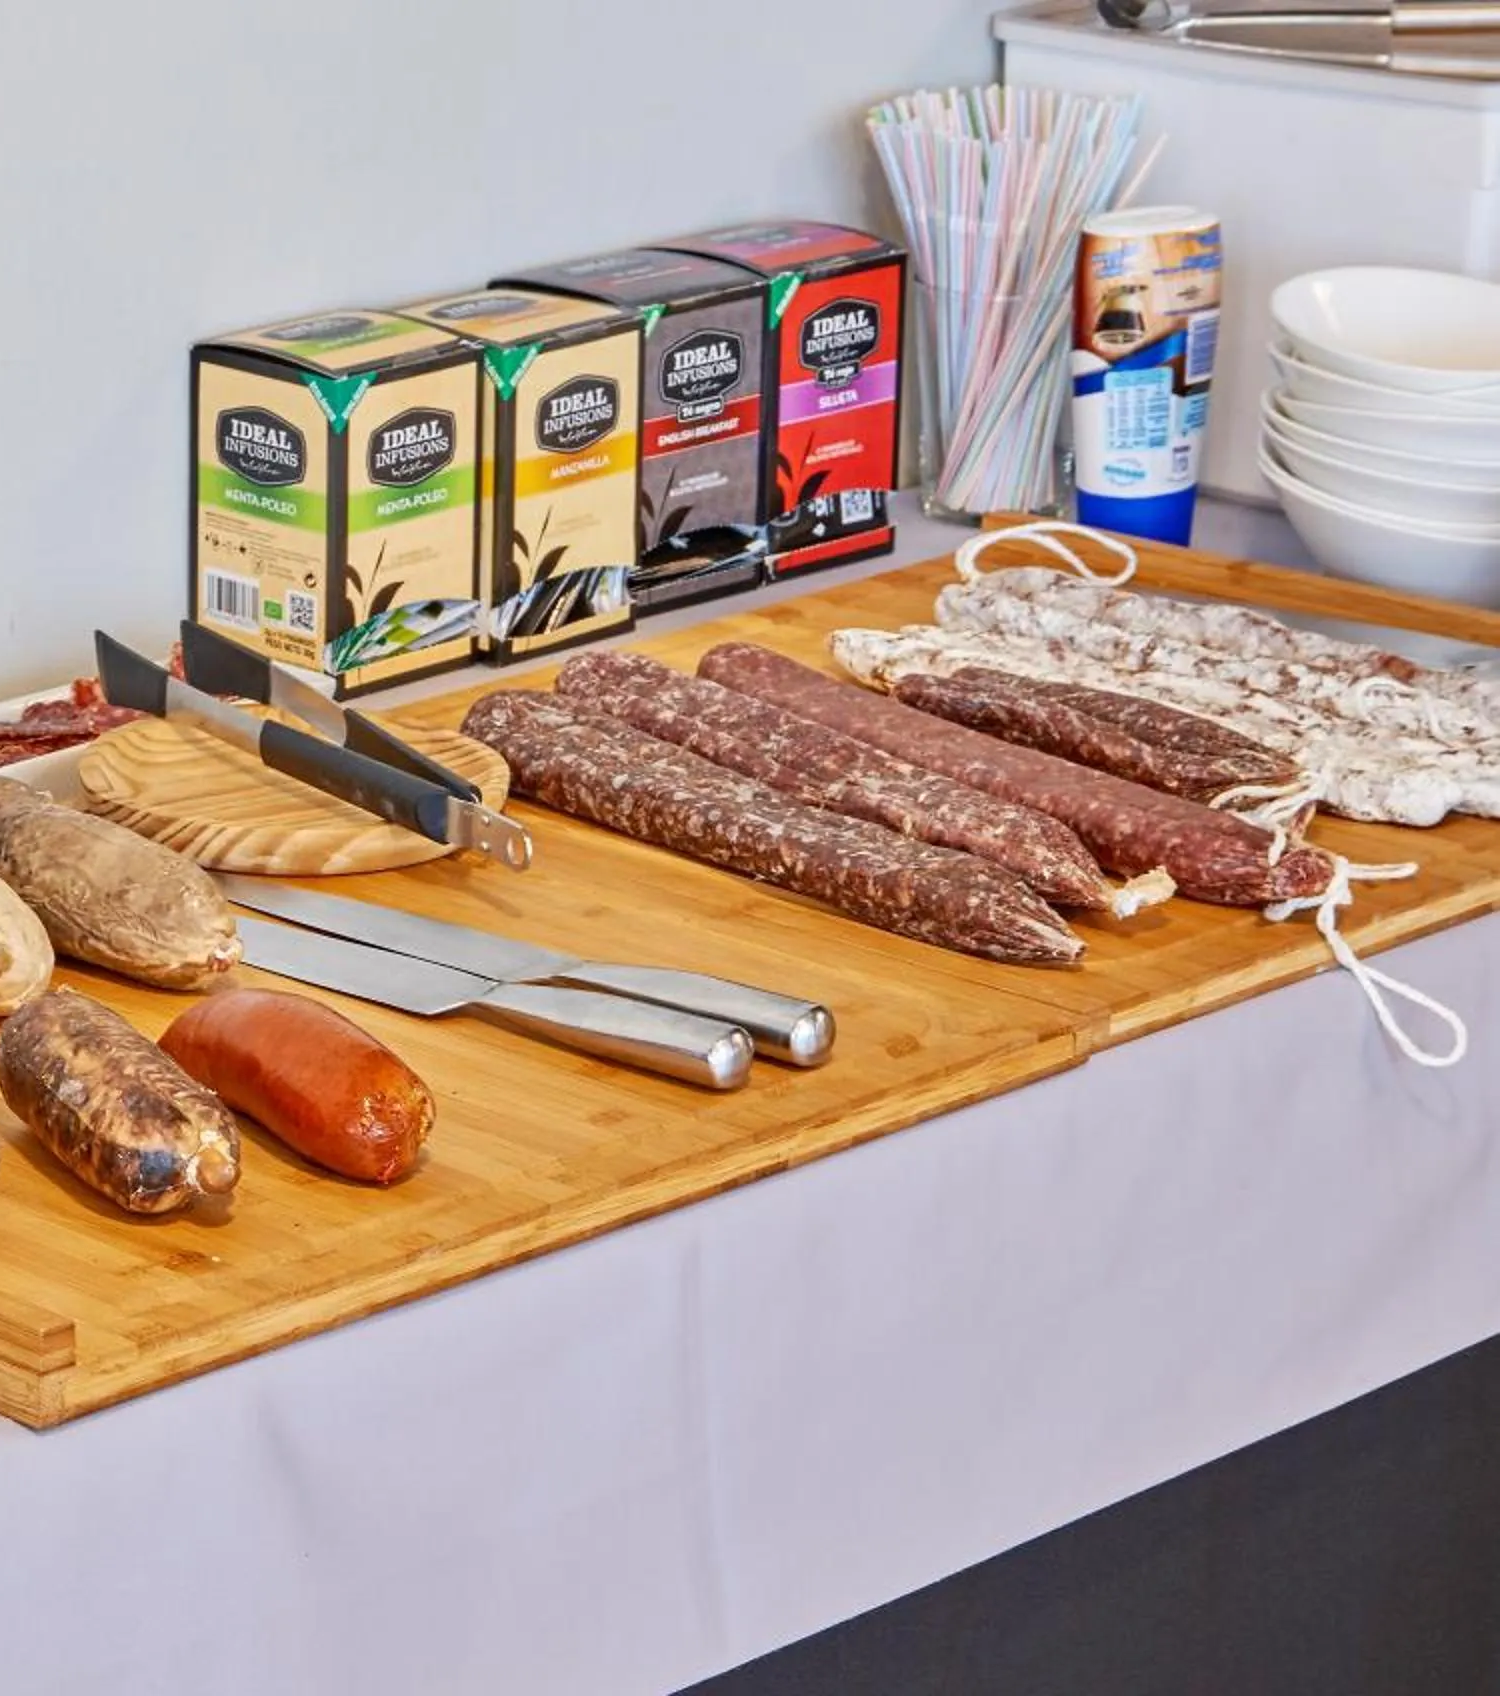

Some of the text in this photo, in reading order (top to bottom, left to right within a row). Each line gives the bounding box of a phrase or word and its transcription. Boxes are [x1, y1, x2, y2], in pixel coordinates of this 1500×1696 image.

[812, 309, 870, 338] IDEAL
[806, 326, 876, 355] INFUSIONS
[673, 341, 731, 371] IDEAL
[667, 358, 737, 387] INFUSIONS
[551, 387, 609, 417] IDEAL
[231, 418, 292, 450] IDEAL
[543, 404, 614, 435] INFUSIONS
[657, 417, 740, 447] ENGLISH BREAKFAST
[381, 419, 443, 451] IDEAL
[224, 436, 299, 467] INFUSIONS
[375, 437, 449, 469] INFUSIONS
[551, 455, 611, 479] MANZANILLA
[225, 487, 297, 515] MENTA-POLEO
[376, 487, 449, 516] MENTA-POLEO
